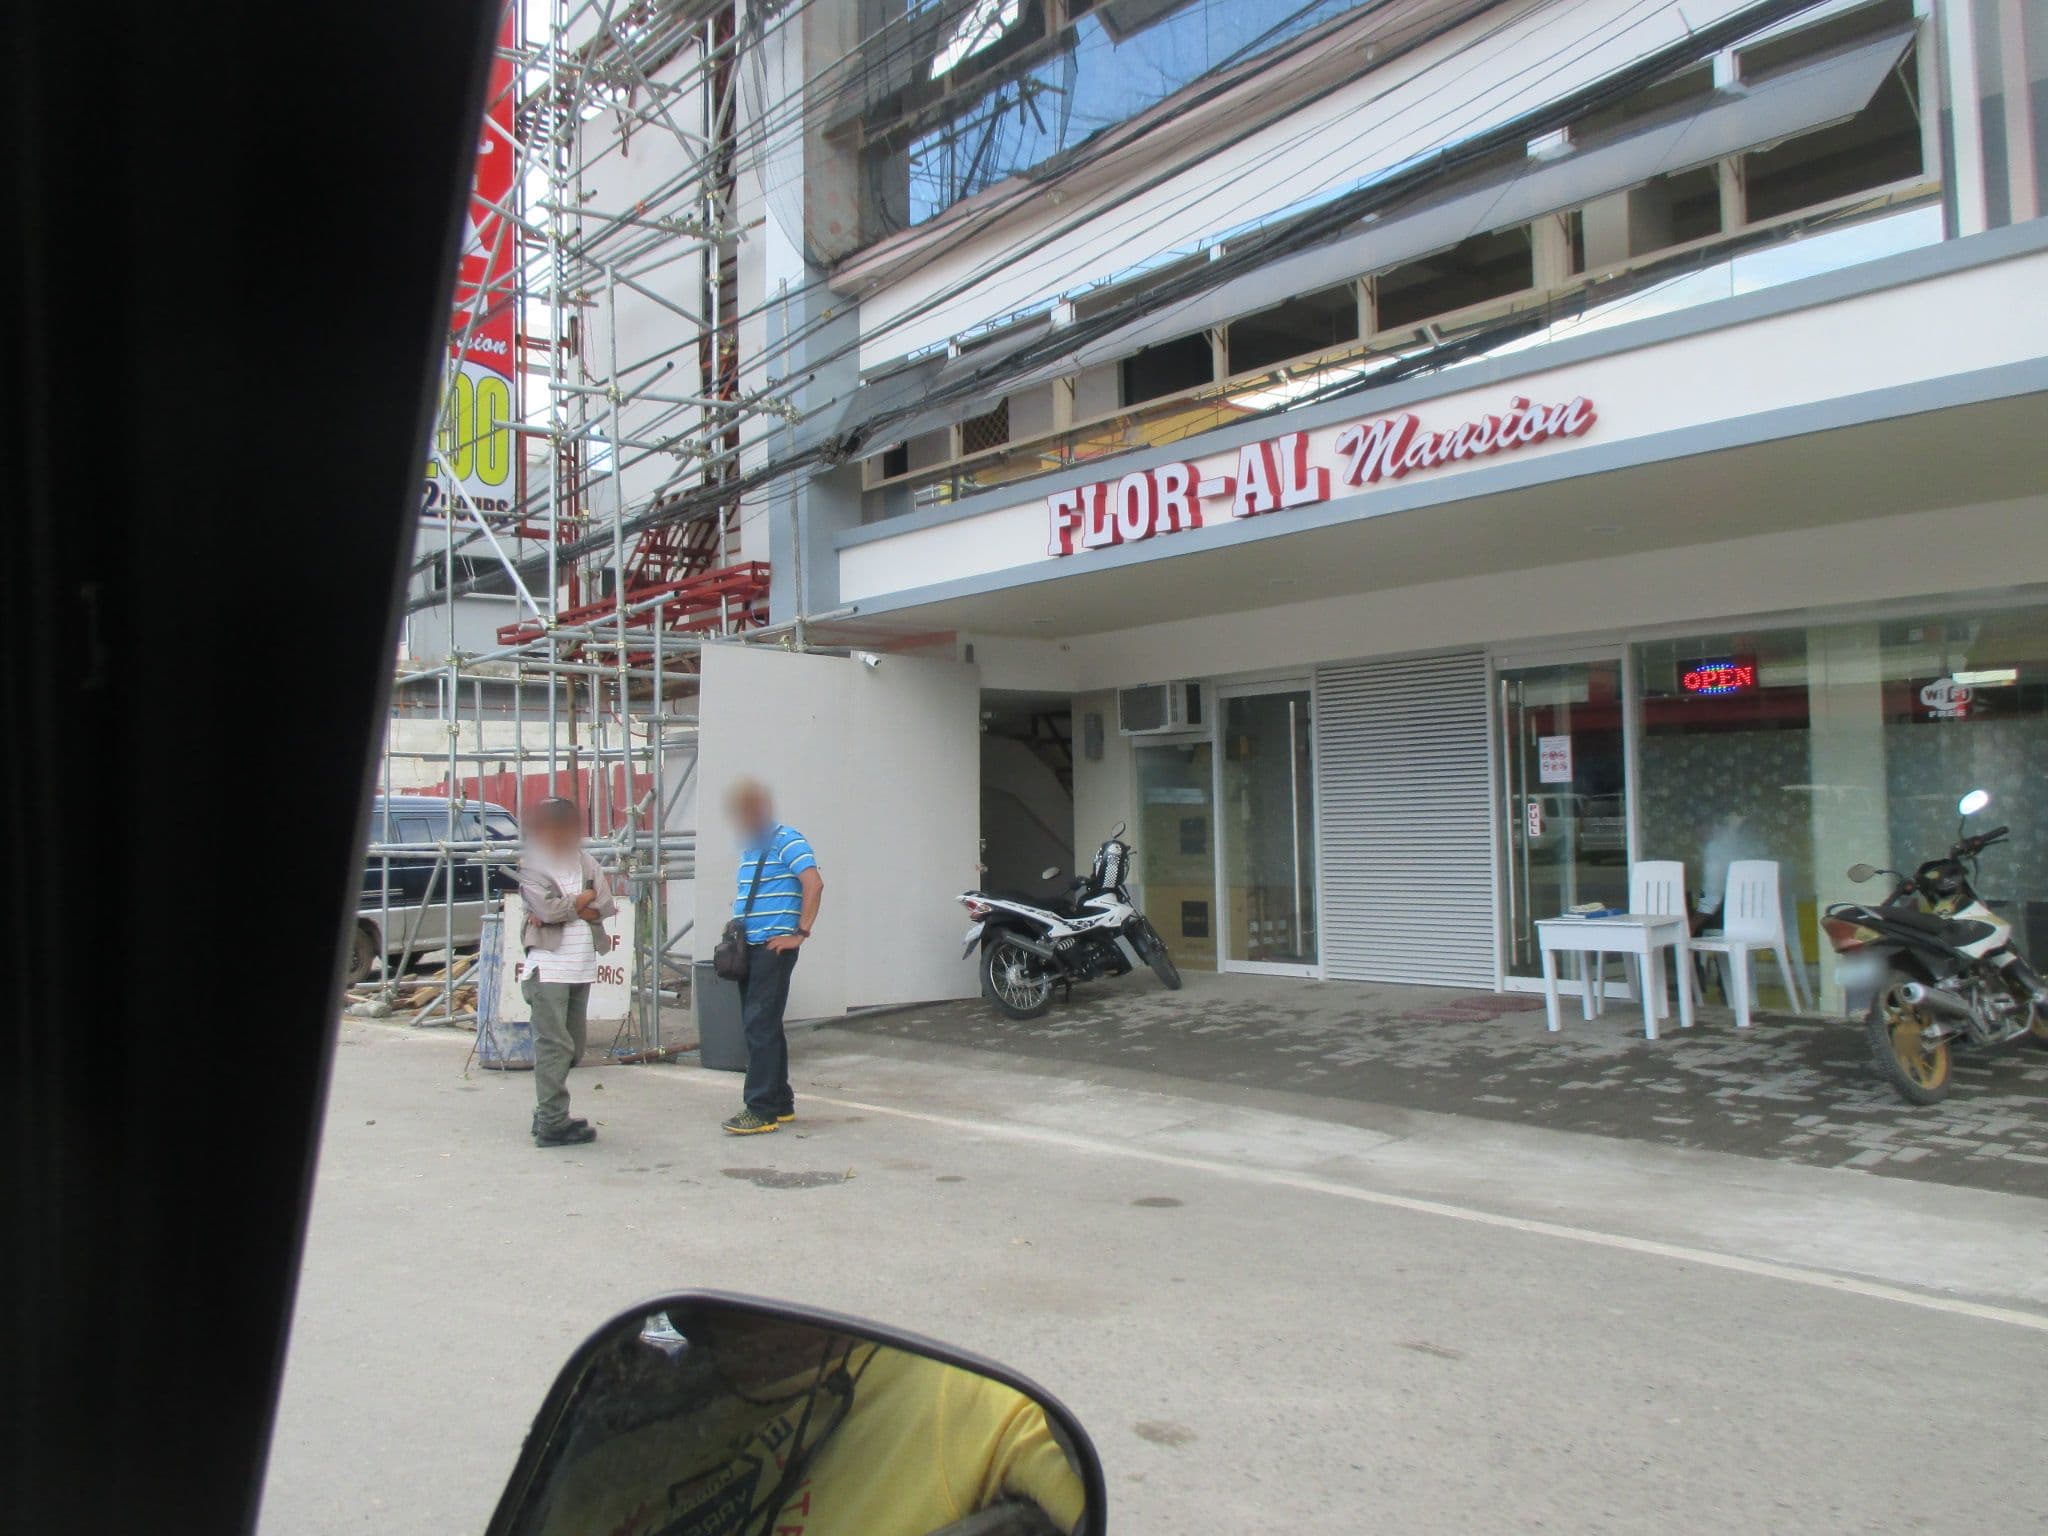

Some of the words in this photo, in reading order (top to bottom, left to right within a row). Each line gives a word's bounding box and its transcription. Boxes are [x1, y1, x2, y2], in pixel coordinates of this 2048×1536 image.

[1047, 431, 1331, 557] FLOR-AL
[1335, 396, 1598, 487] Mansion
[1683, 666, 1752, 690] OPEN
[1529, 804, 1538, 835] PULL
